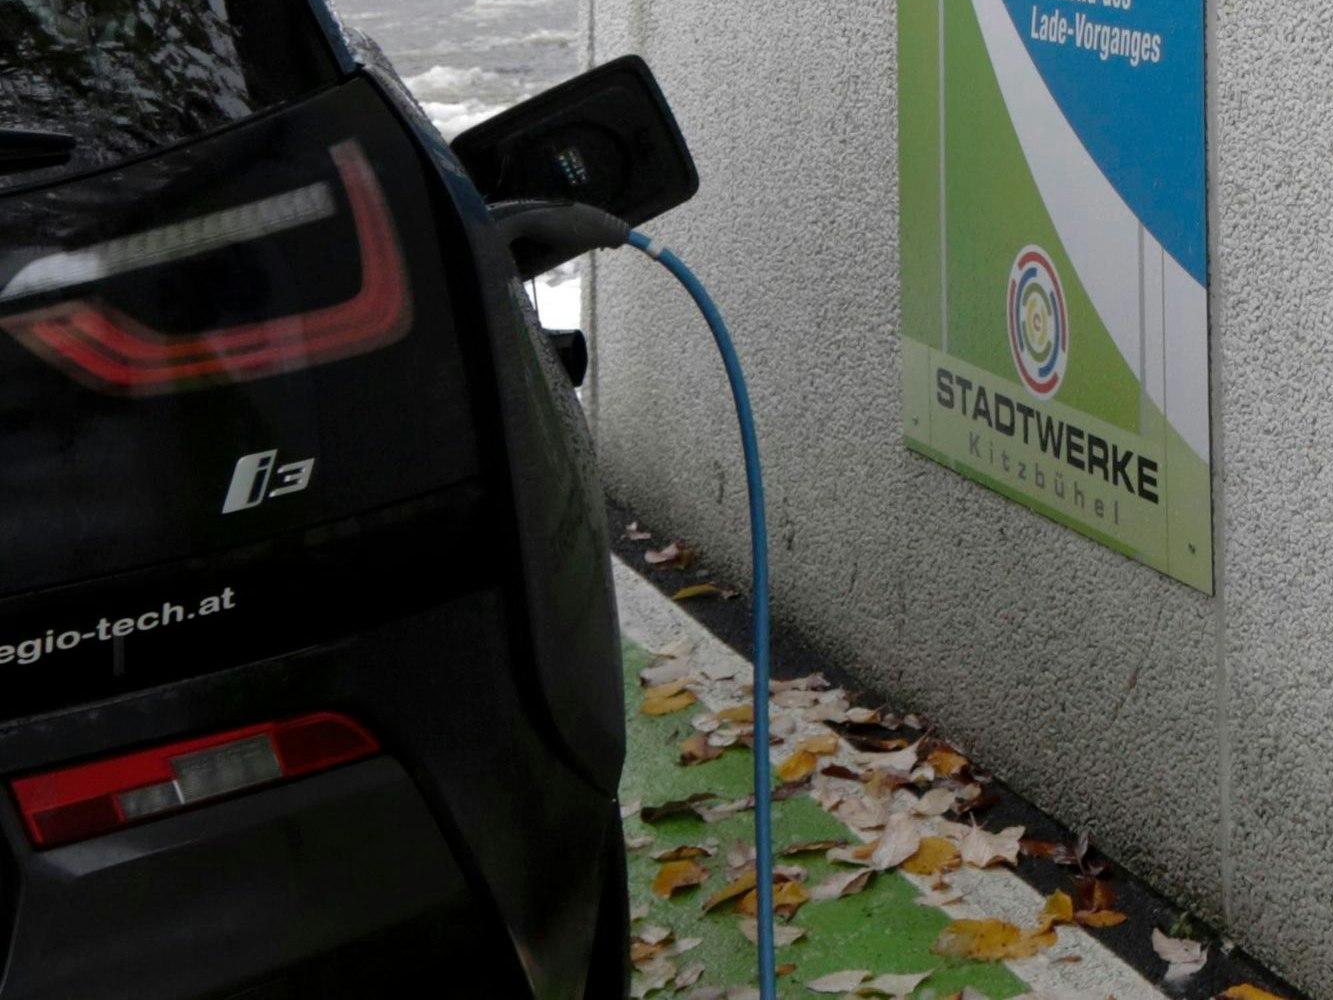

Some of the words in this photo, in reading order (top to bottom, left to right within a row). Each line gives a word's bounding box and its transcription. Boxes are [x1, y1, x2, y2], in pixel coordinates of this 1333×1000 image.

[1031, 5, 1161, 67] Lade-Vorganges
[937, 367, 1159, 505] STADTWERKE
[222, 449, 316, 514] i3
[969, 431, 1119, 525] Kitzbühel
[0, 587, 236, 665] egio-tech.at
